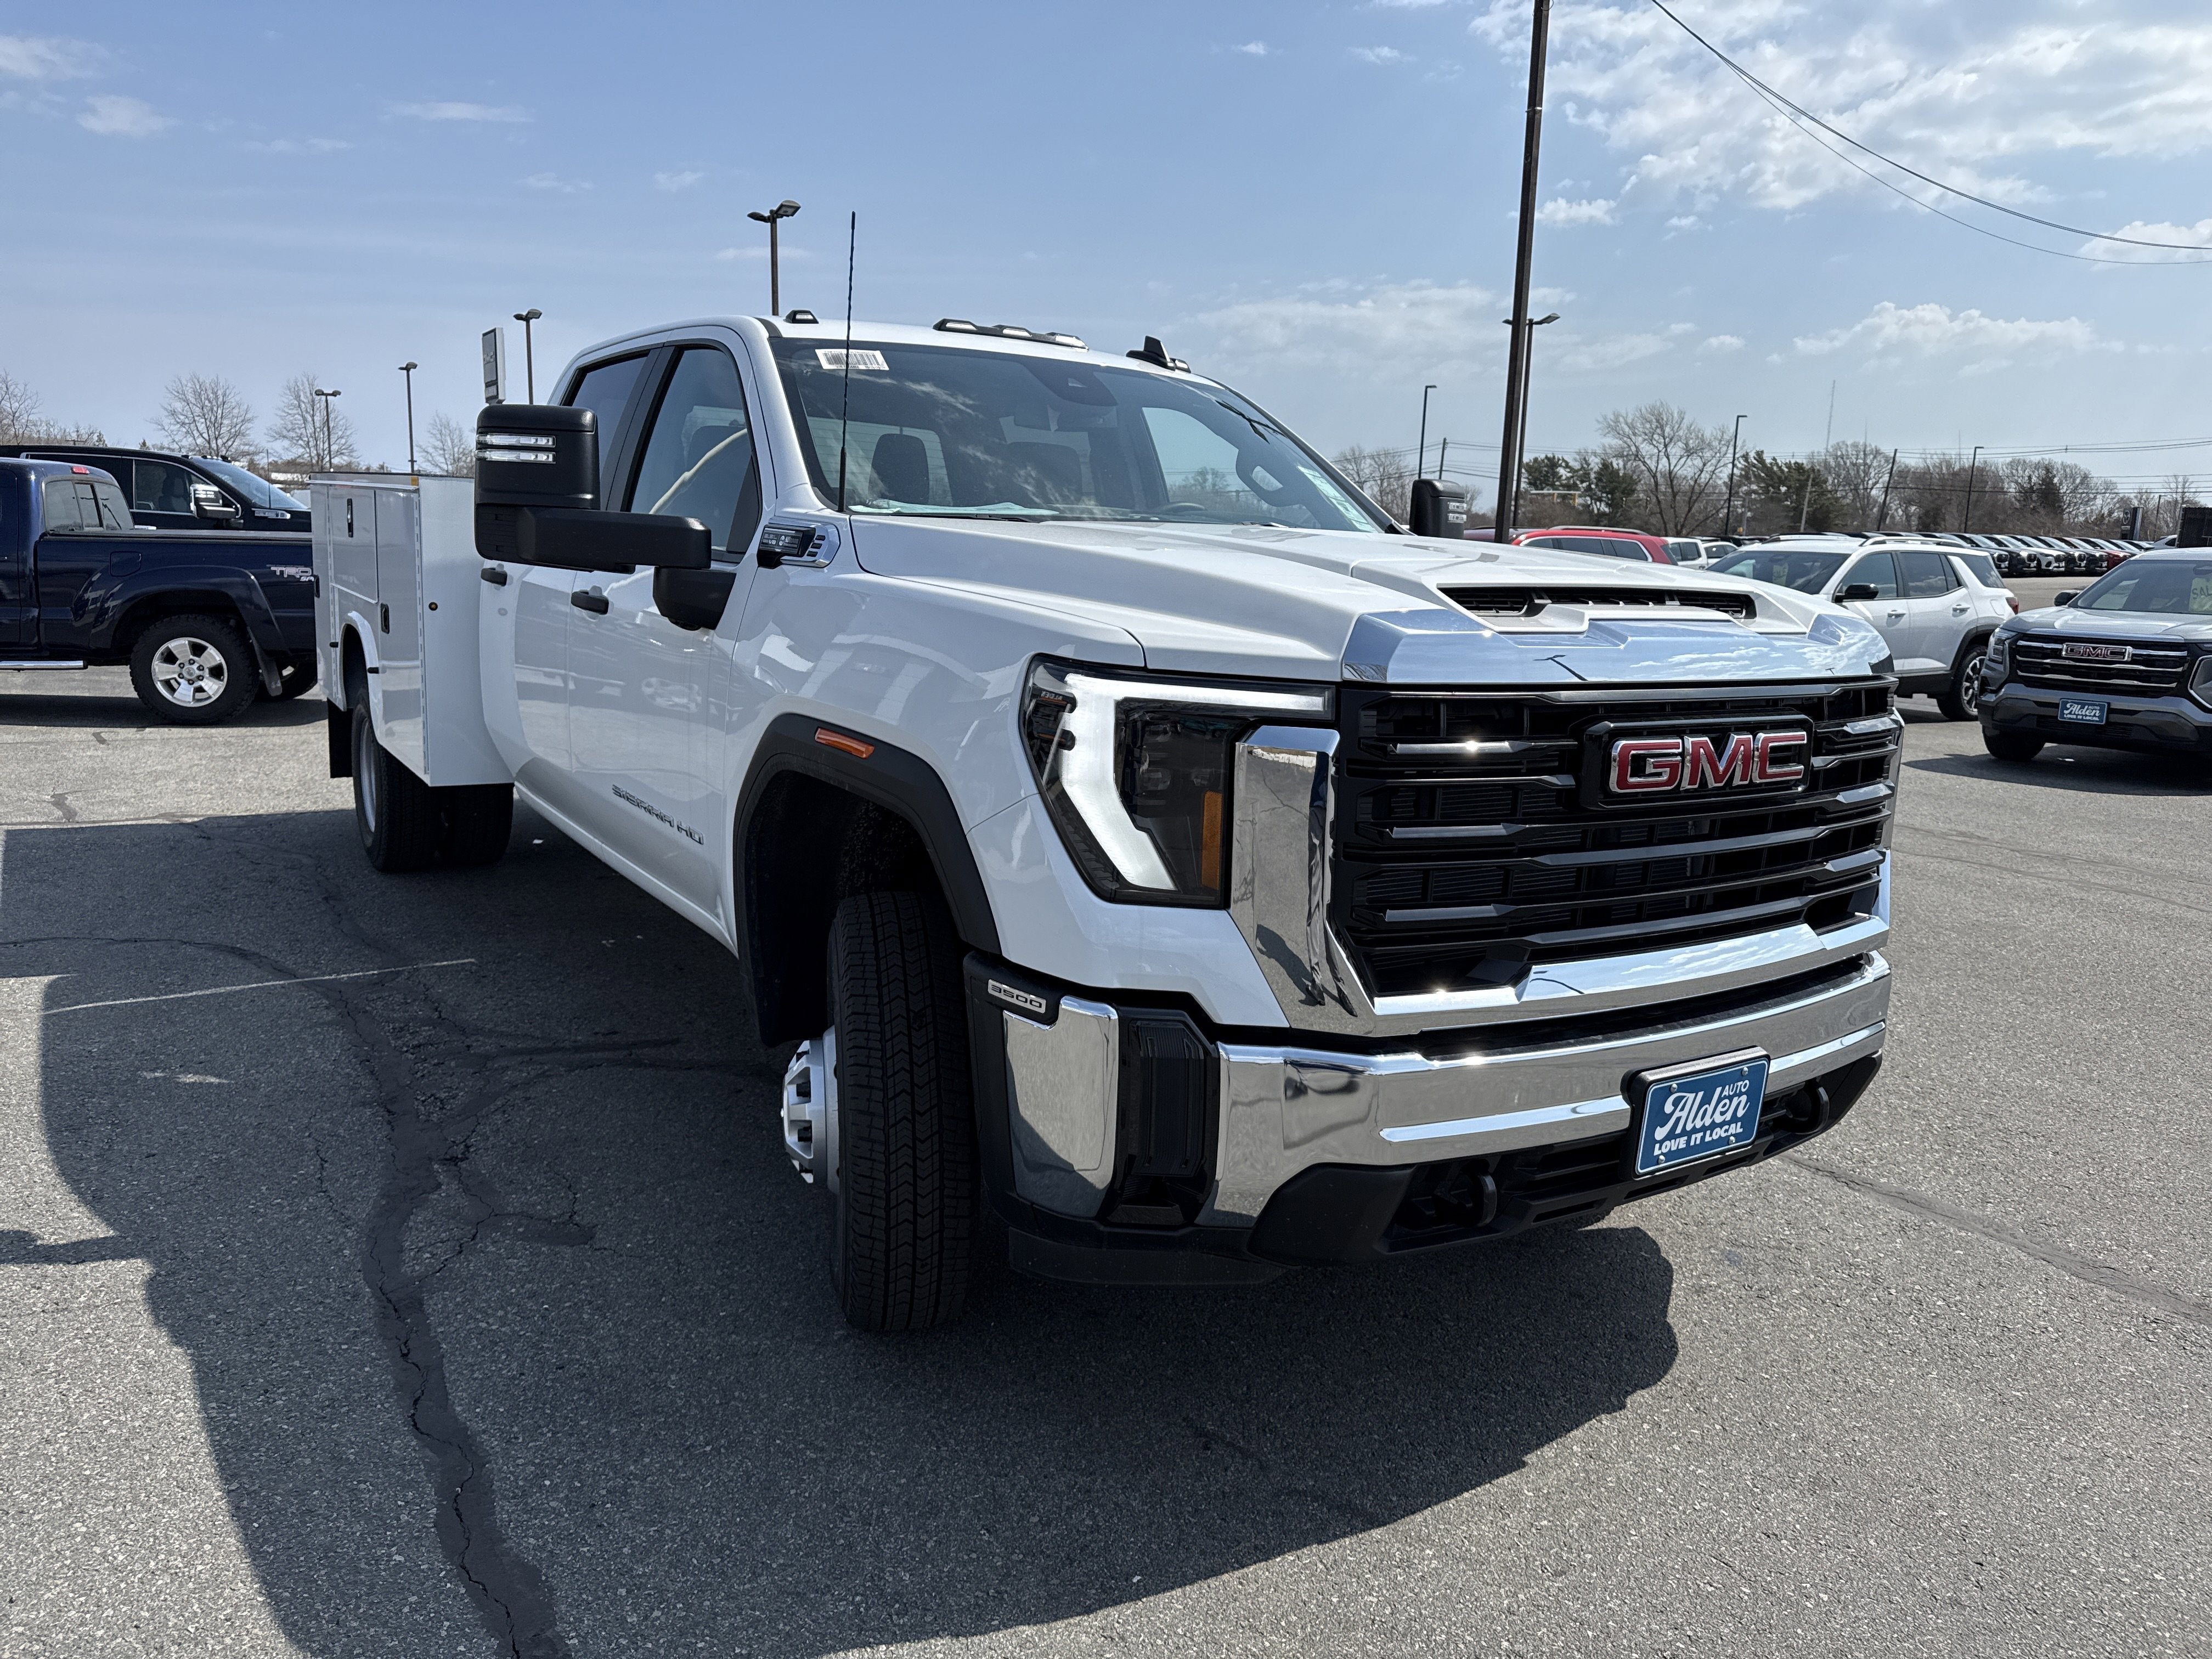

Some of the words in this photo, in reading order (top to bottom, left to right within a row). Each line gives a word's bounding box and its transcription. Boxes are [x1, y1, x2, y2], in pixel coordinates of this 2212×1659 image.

[270, 566, 312, 578] TRD
[2066, 645, 2125, 659] GMC
[2063, 703, 2101, 716] Alden
[1609, 731, 1807, 793] GMC
[612, 784, 674, 827] SIERRA
[677, 821, 704, 845] HD
[991, 984, 1042, 1008] 3500
[1722, 1080, 1750, 1098] AUTO
[1654, 1086, 1750, 1141] Alden
[1654, 1136, 1688, 1156] LOVE
[1690, 1132, 1703, 1146] IT
[1705, 1121, 1743, 1142] LOCAL
